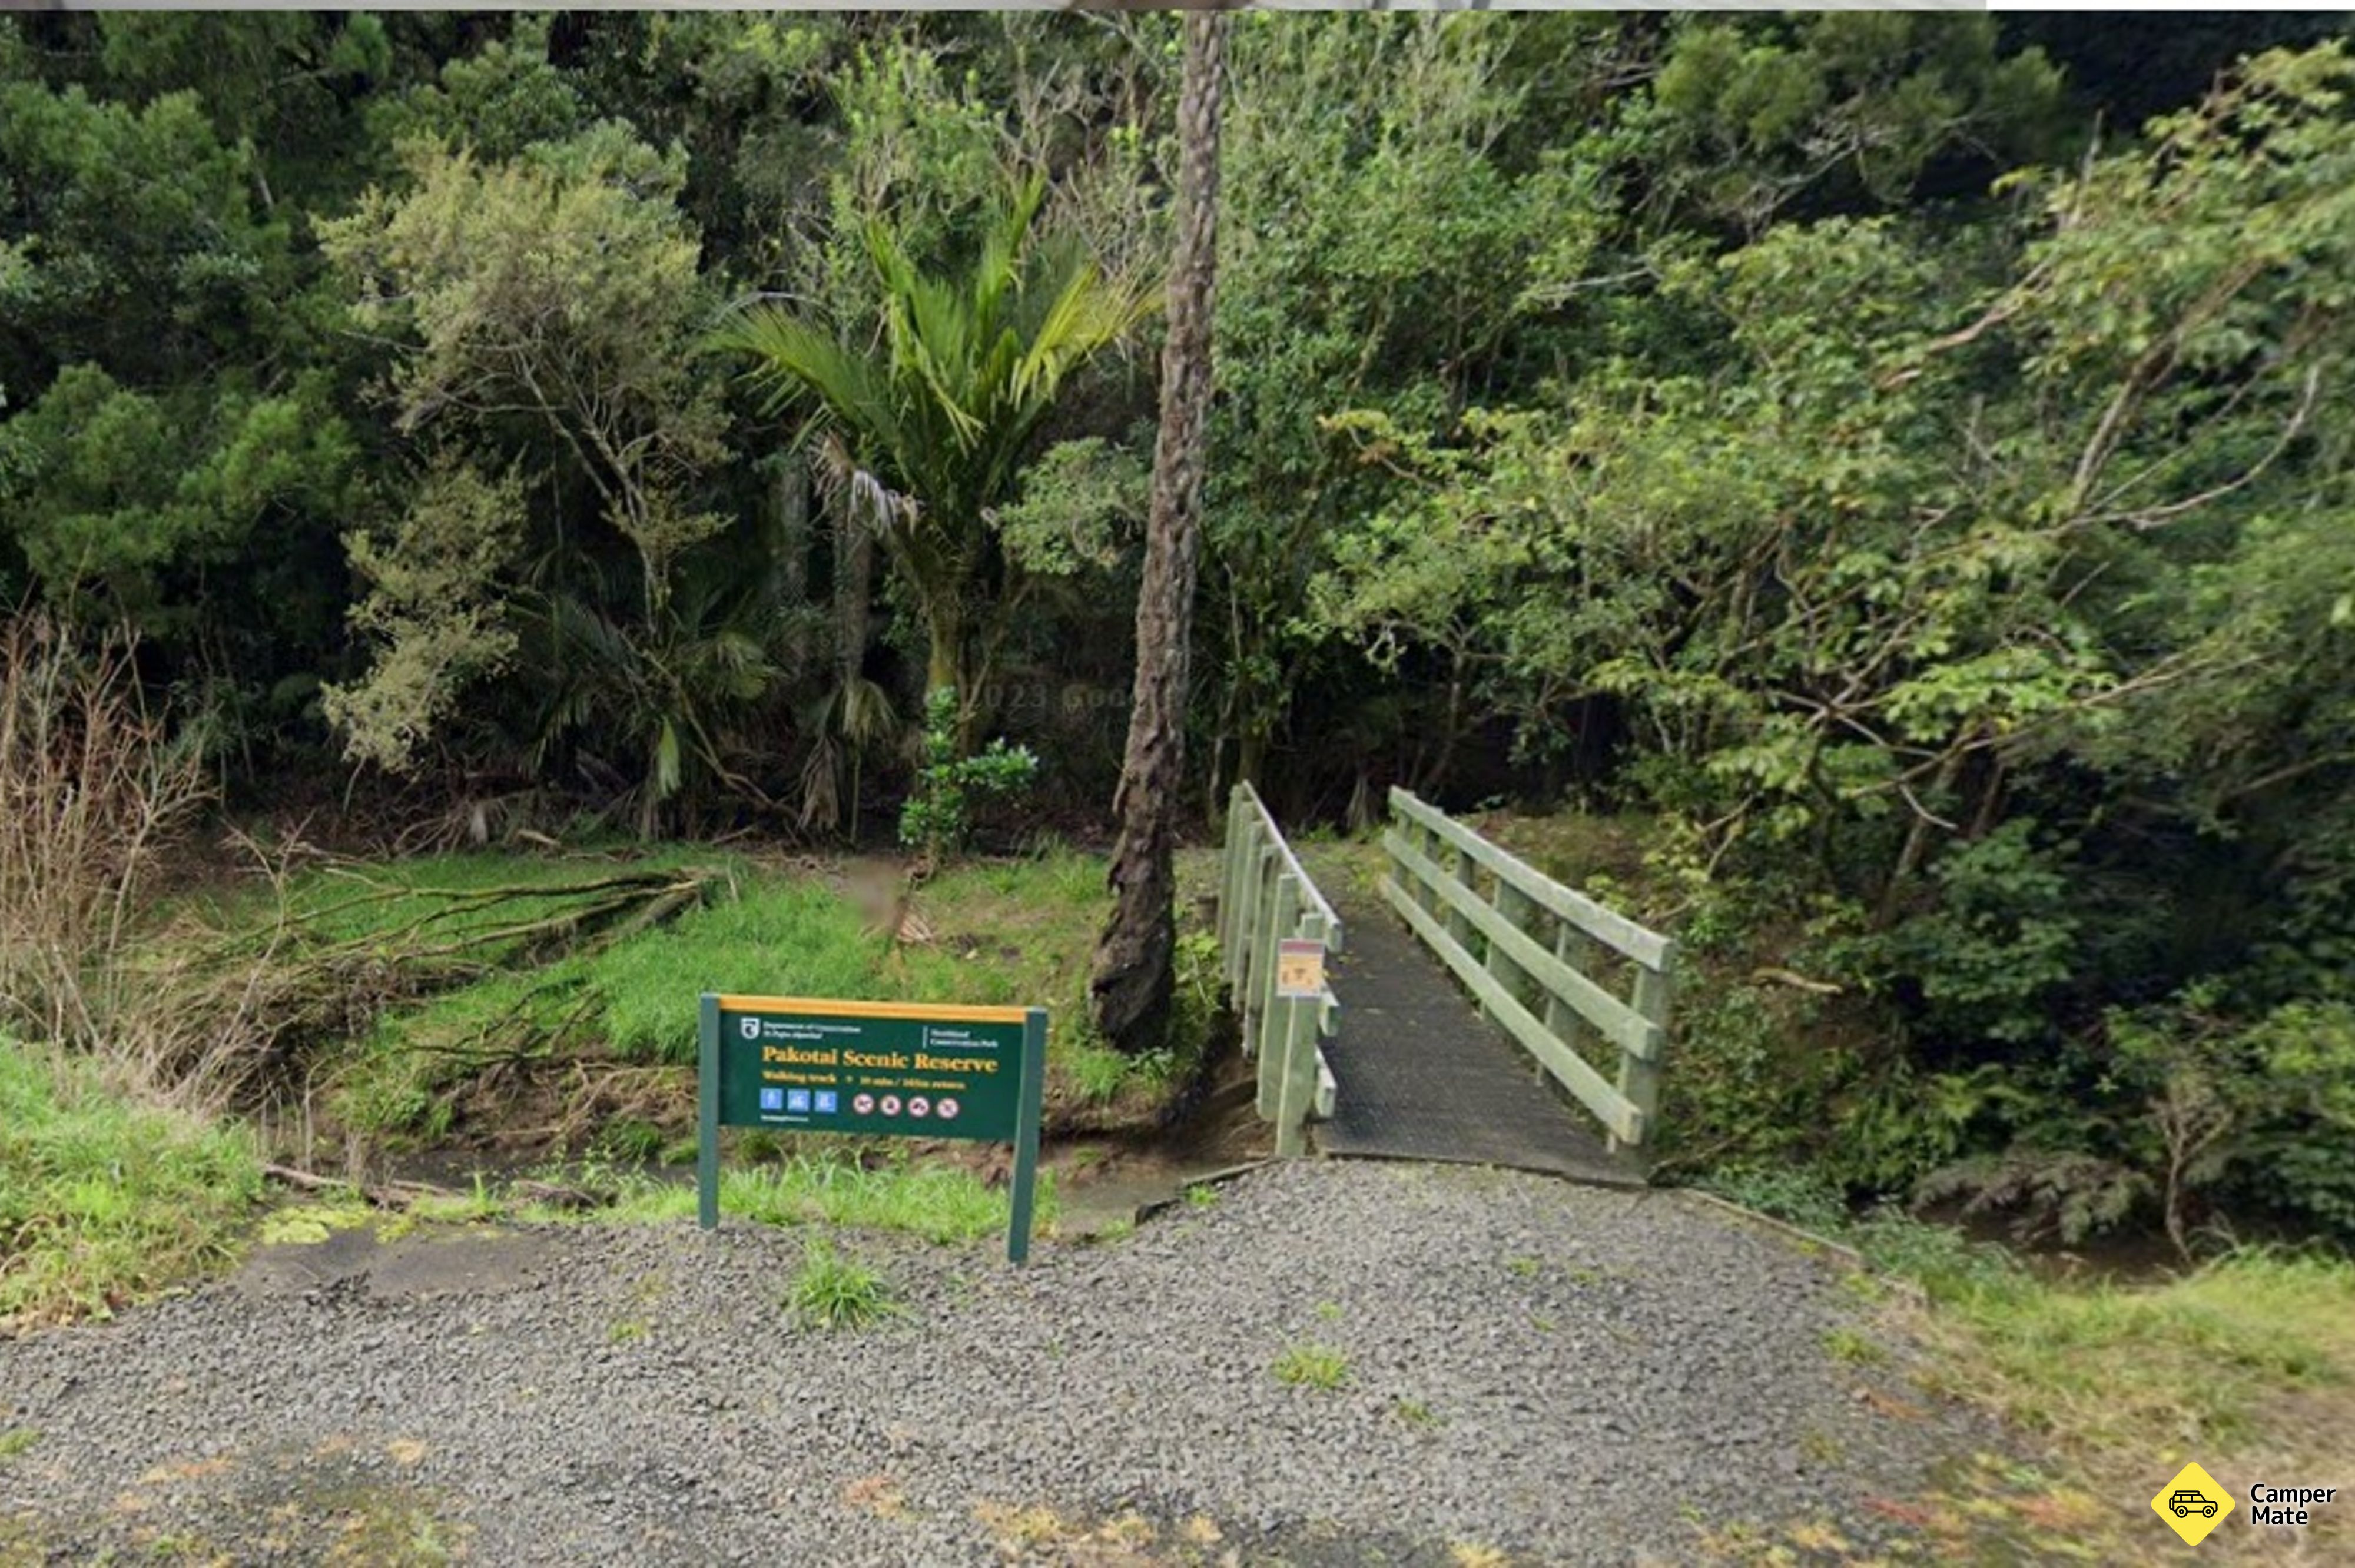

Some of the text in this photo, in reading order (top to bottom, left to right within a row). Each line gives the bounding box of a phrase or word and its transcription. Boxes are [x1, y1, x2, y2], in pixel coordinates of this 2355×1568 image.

[762, 1045, 999, 1074] Pakotai Scenic Reserve
[762, 1070, 807, 1084] Walking
